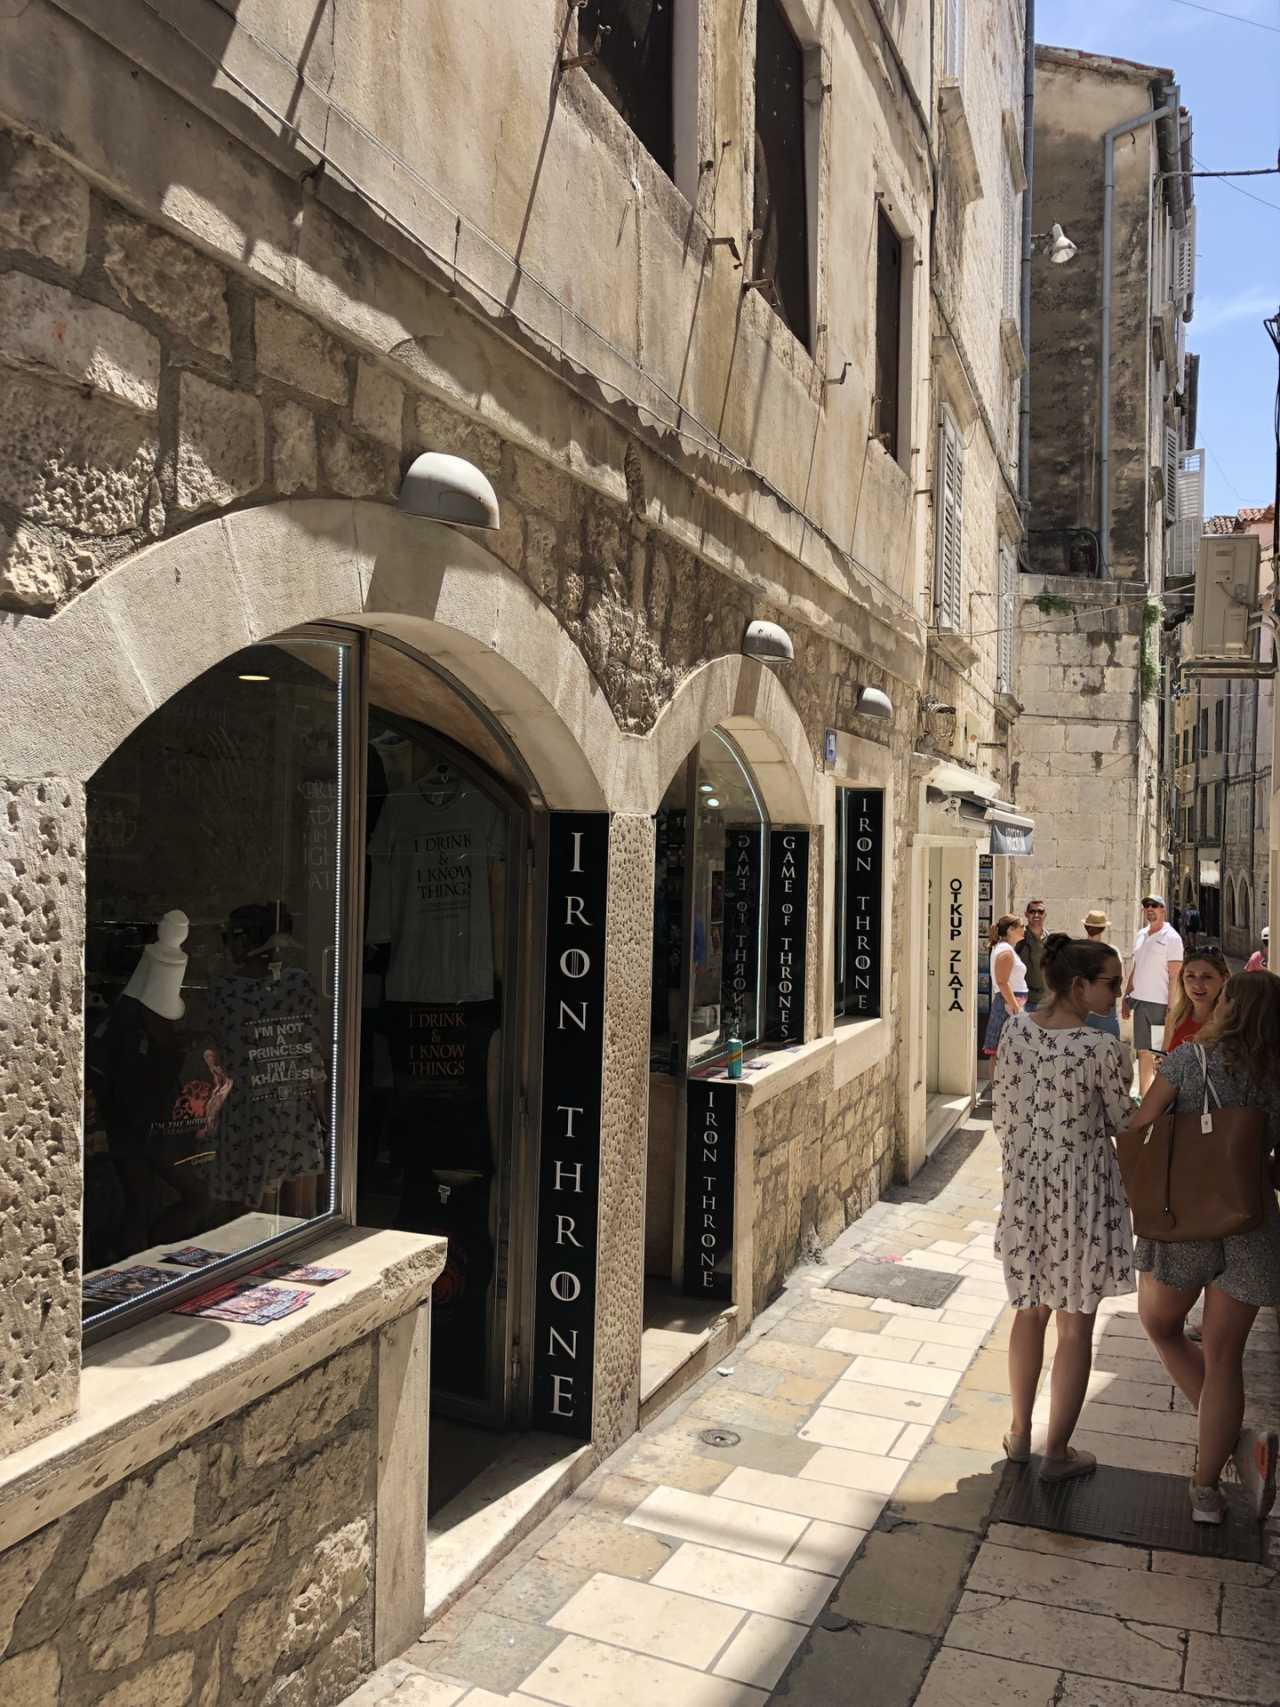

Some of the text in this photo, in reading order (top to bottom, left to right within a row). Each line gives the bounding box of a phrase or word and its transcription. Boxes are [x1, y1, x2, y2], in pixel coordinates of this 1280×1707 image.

[414, 839, 419, 852] I
[439, 851, 448, 866] &
[417, 865, 472, 883] I KNOW
[855, 798, 873, 1009] IRON THRONE
[778, 836, 796, 1038] GAME OF THRONES
[948, 878, 964, 1012] OTKUP ZLATA
[409, 1011, 465, 1027] I DRINK
[254, 1022, 304, 1039] I'M NOT
[431, 1028, 441, 1043] &
[276, 1034, 286, 1045] A
[248, 1042, 313, 1061] PRINCESS
[410, 1043, 465, 1059] I KNOW
[267, 1060, 297, 1073] I'M A
[409, 1060, 465, 1075] THINGS
[546, 832, 593, 1417] IRON THRONE
[700, 1091, 719, 1288] IRON THRONE
